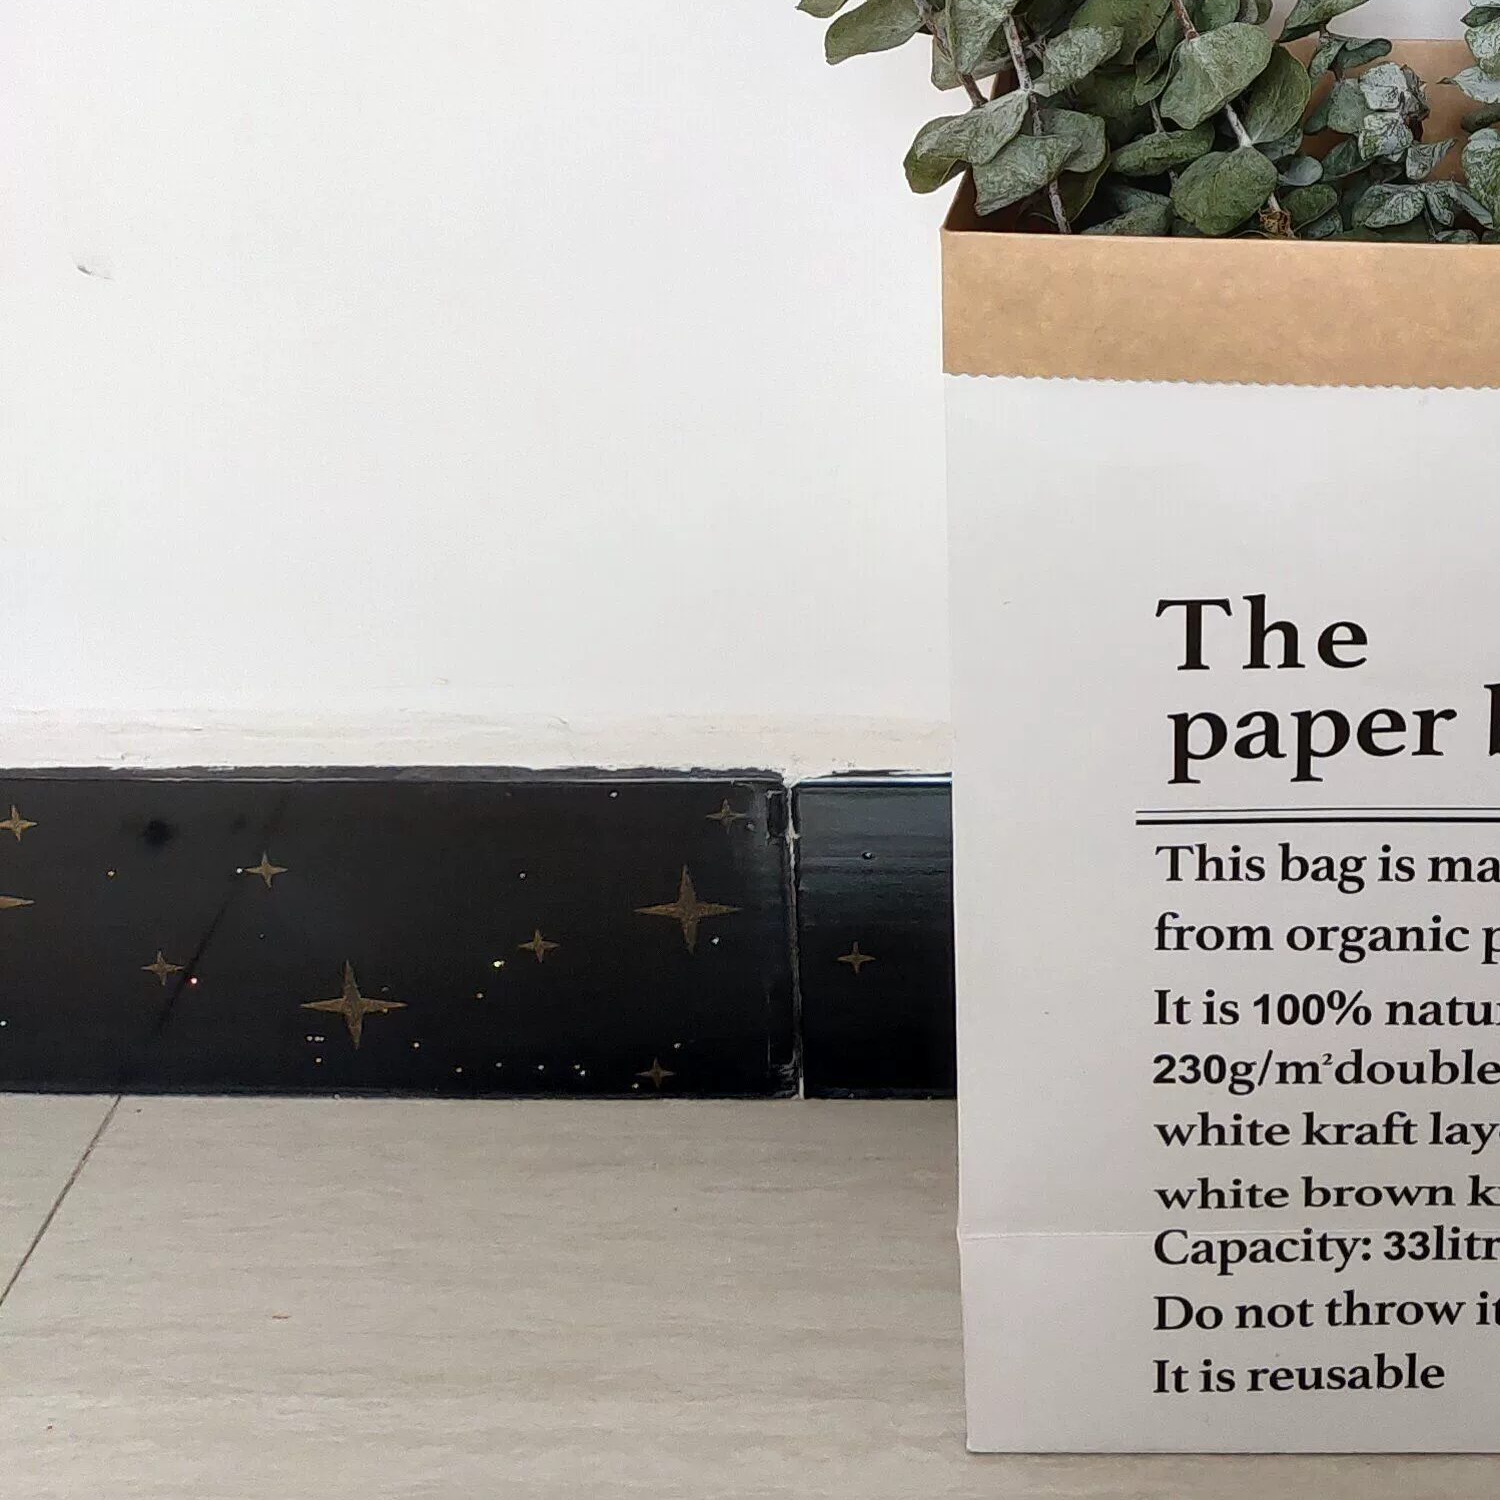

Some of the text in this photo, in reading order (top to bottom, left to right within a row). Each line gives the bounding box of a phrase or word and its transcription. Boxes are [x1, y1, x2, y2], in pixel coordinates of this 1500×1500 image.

[1155, 593, 1368, 671] The
[1166, 708, 1458, 785] paper
[1154, 842, 1266, 882] This
[1277, 842, 1368, 895] bag
[1377, 843, 1416, 883] is
[1154, 911, 1275, 951] from
[1286, 914, 1470, 964] organic
[1153, 989, 1192, 1025] It
[1202, 988, 1240, 1026] is
[1253, 989, 1373, 1026] 100%
[1153, 1111, 1291, 1147] white
[1301, 1110, 1419, 1146] kraft
[1153, 1176, 1290, 1210] white
[1300, 1175, 1457, 1208] brown
[1153, 1227, 1372, 1277] Capacity:
[1152, 1295, 1224, 1331] Do
[1234, 1298, 1315, 1329] not
[1324, 1289, 1467, 1327] throw
[1152, 1351, 1446, 1394] It is reusable
